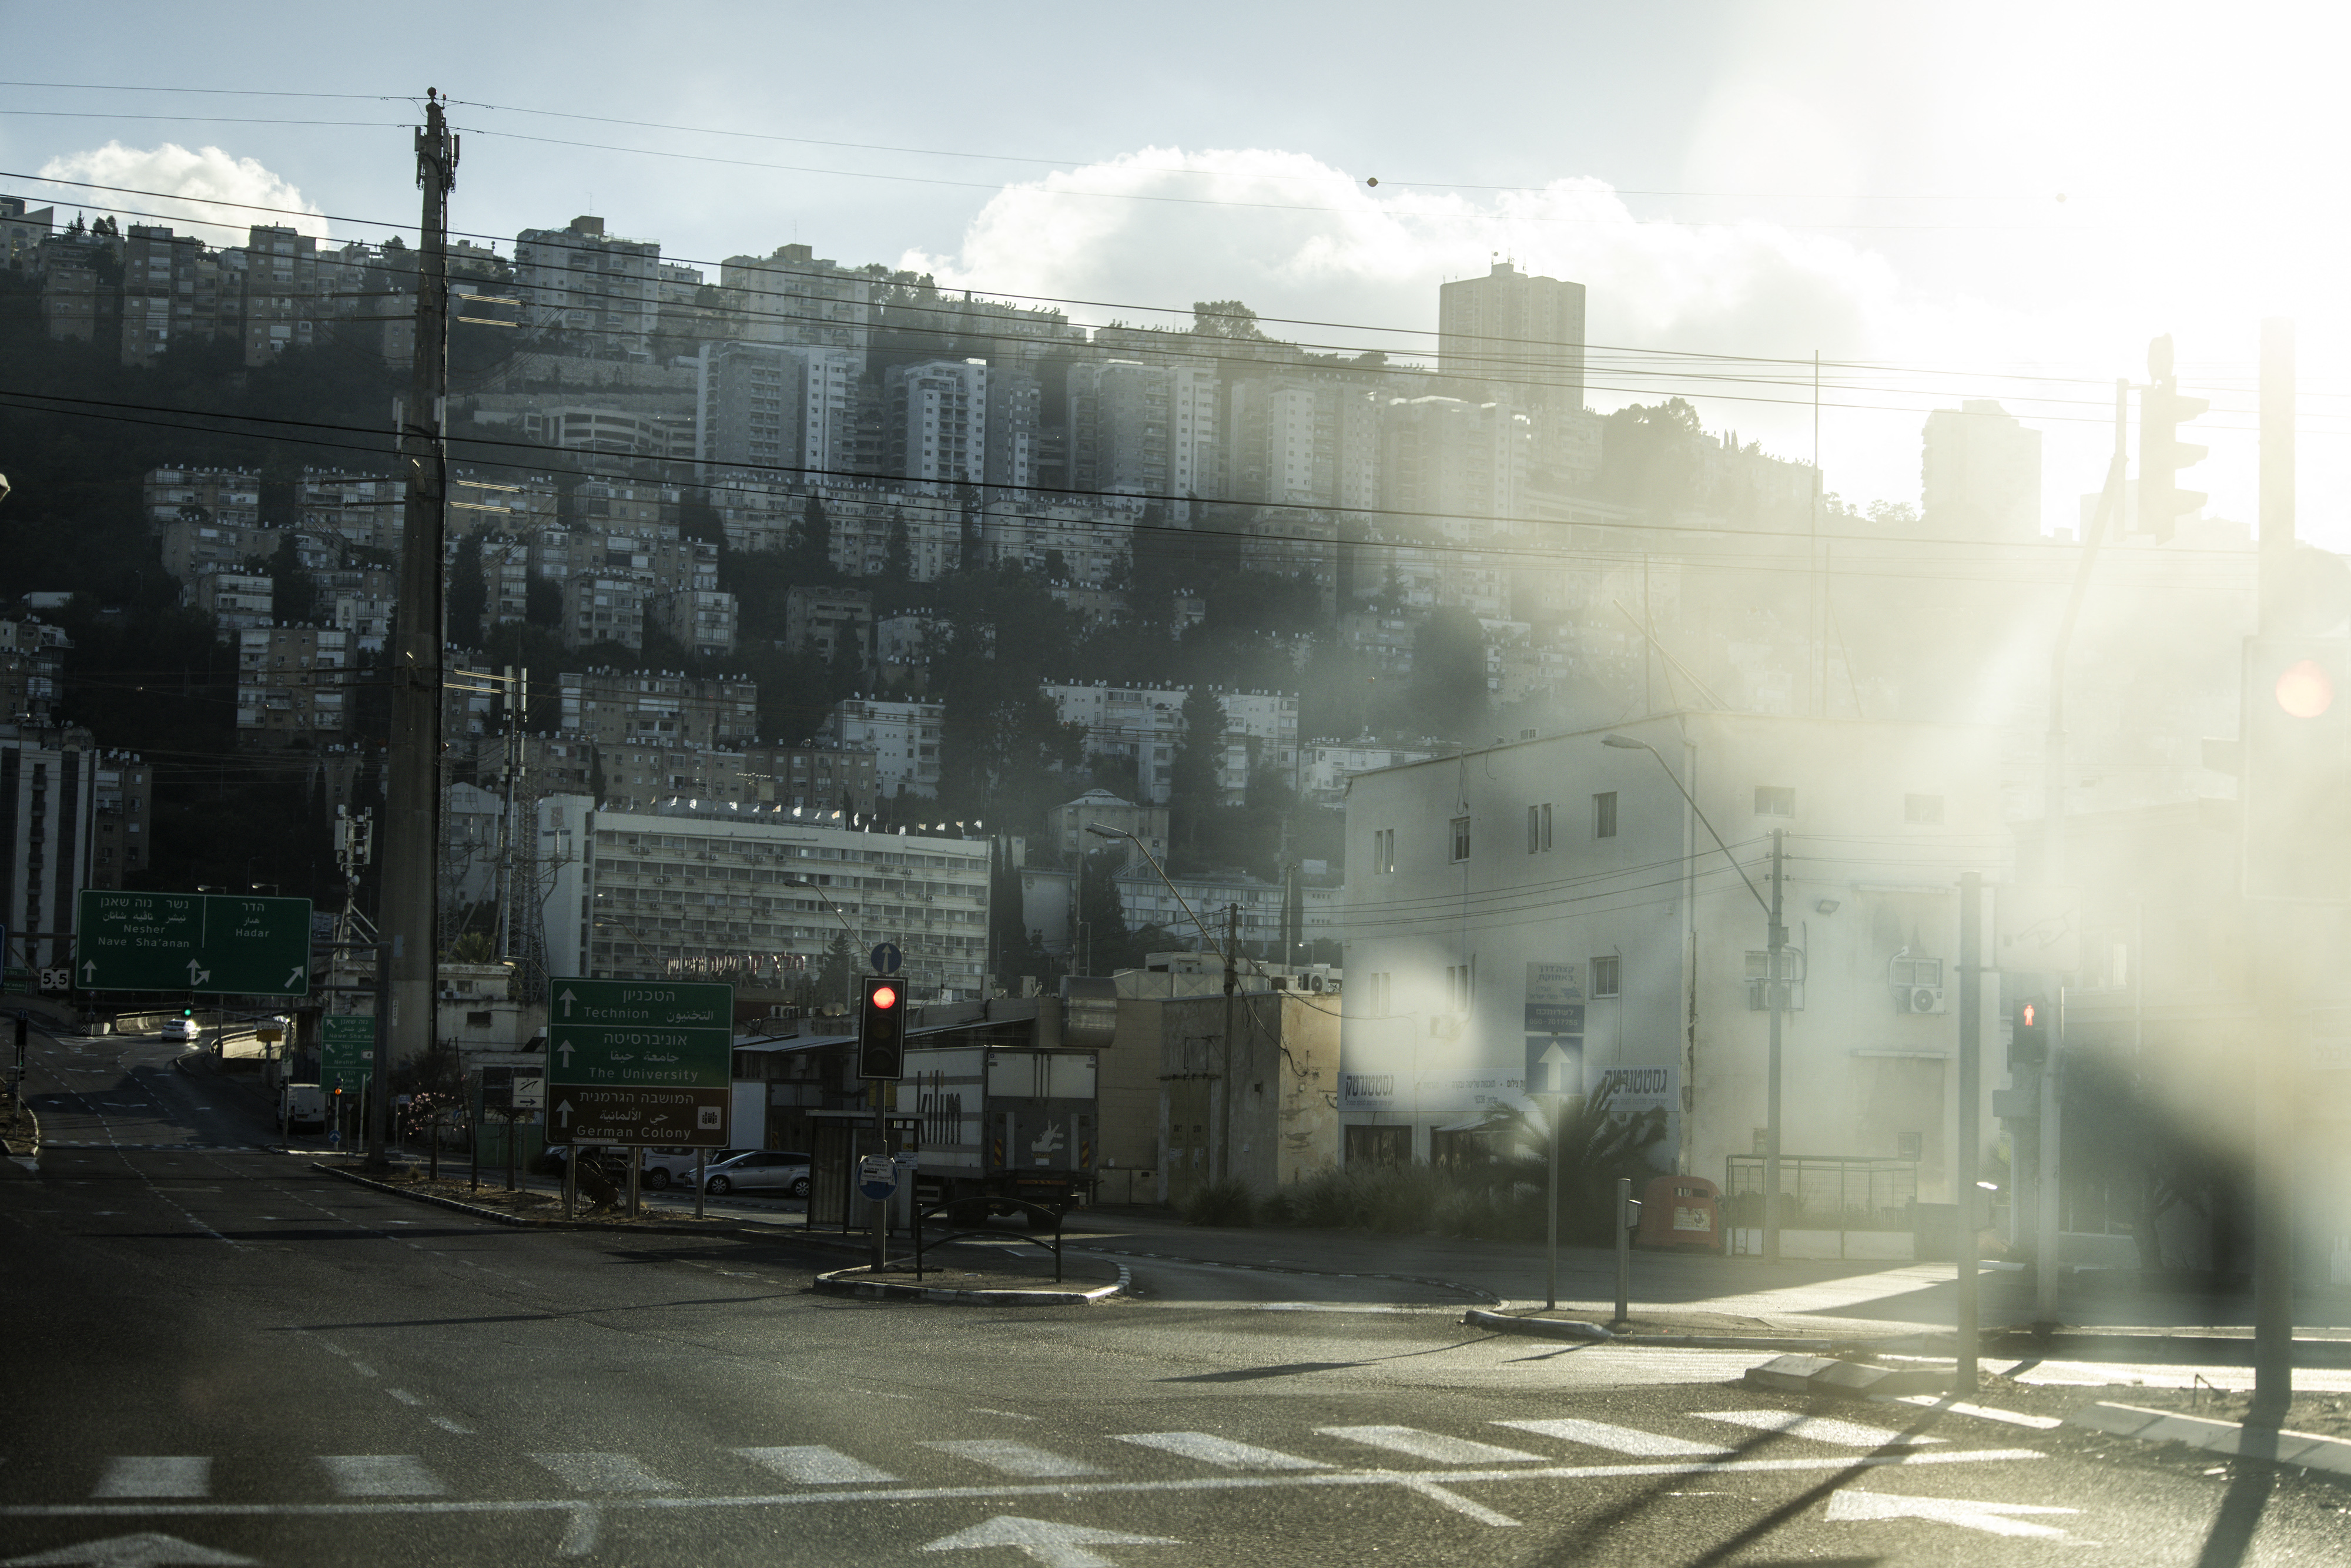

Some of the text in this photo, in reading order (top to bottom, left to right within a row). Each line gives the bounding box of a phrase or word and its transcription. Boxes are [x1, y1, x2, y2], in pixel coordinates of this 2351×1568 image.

[101, 897, 189, 909] נשר נוה שאנן
[242, 903, 264, 912] הדר
[166, 914, 186, 924] نيشر
[243, 917, 260, 926] هدار
[123, 924, 165, 934] Nesher
[236, 929, 269, 937] Hadar
[98, 937, 189, 948] Nave Sha'anan
[709, 956, 763, 976] קרמיקה
[43, 973, 66, 984] 5.5
[623, 990, 675, 1003] הטכניון
[584, 1007, 649, 1018] Technion
[667, 1010, 714, 1023] التخنيون
[604, 1033, 687, 1046] אוניברסיטה
[610, 1051, 679, 1064] جامعة حيفا
[589, 1068, 698, 1083] The University
[1345, 1075, 1394, 1100] גסטטנרטק
[580, 1092, 694, 1104] המושבה הגרמנית
[600, 1107, 669, 1125] حي الألمانية
[577, 1125, 691, 1140] German Colony
